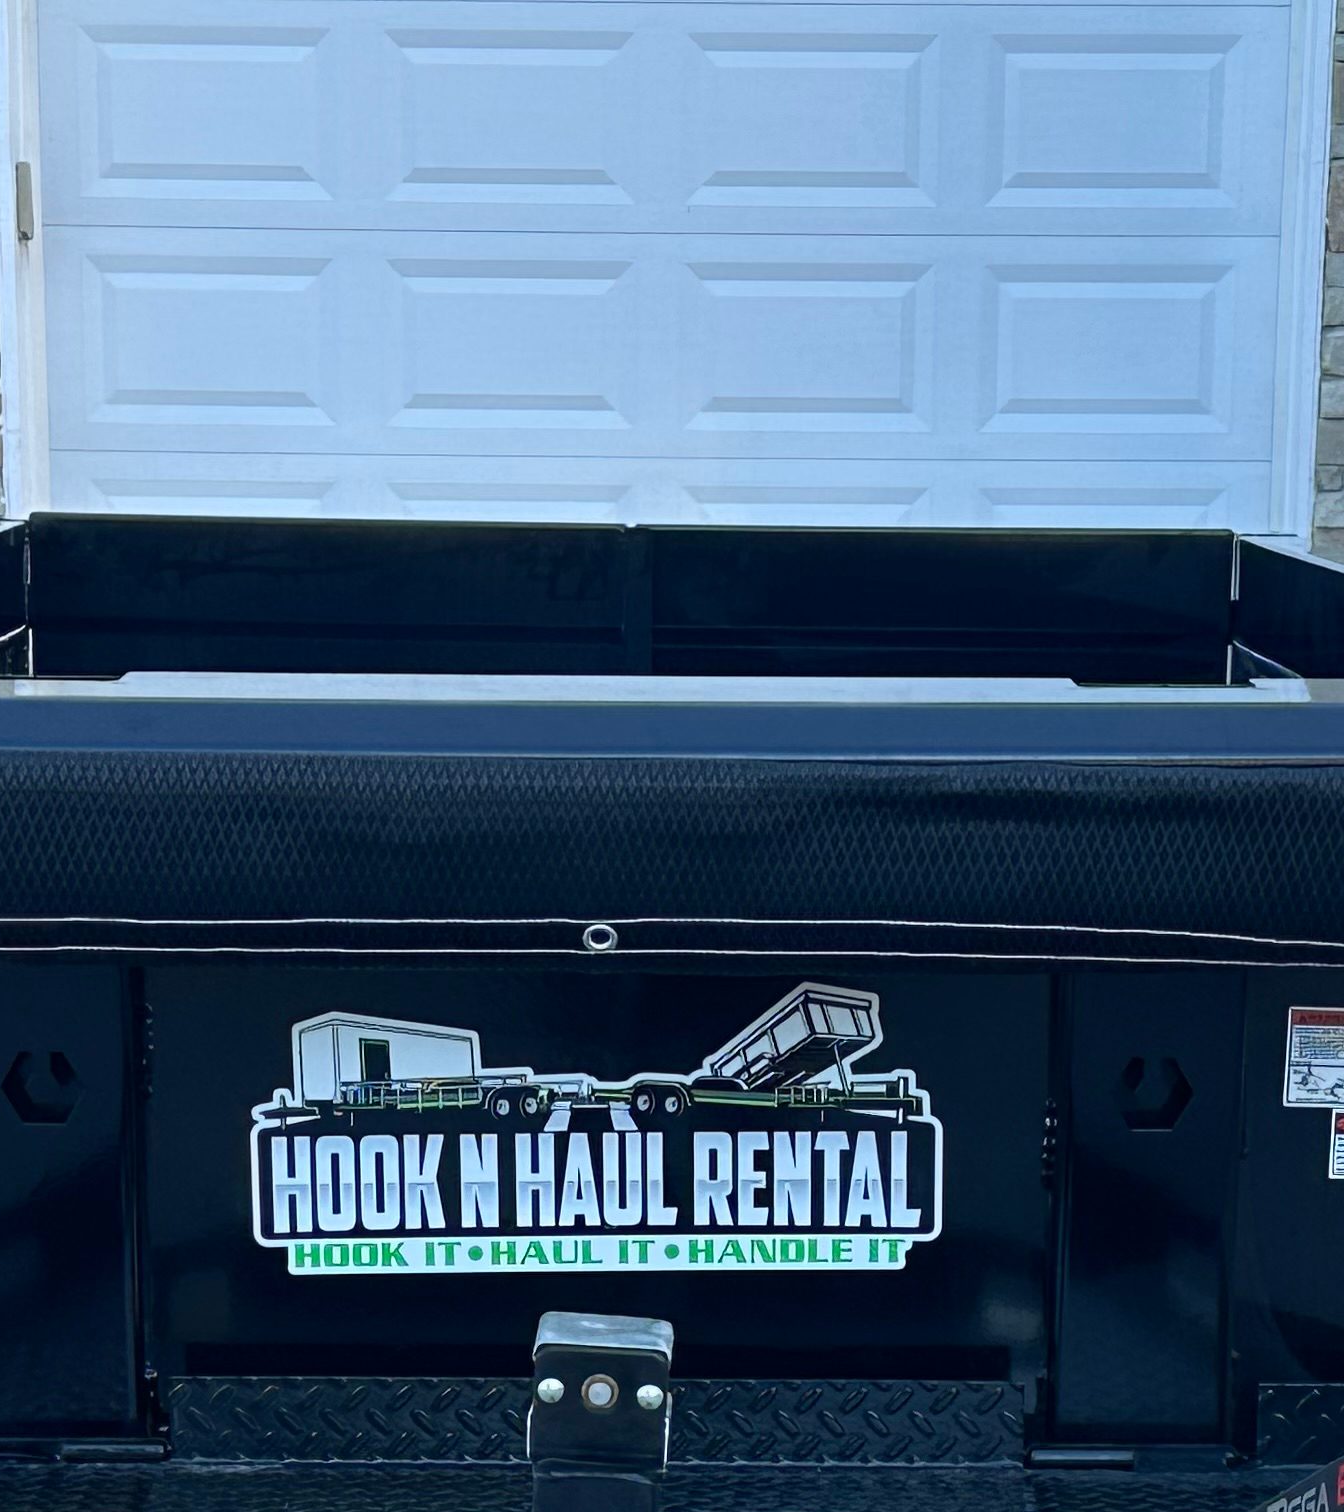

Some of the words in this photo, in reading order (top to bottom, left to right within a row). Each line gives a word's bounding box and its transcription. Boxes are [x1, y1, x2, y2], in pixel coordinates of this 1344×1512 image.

[273, 1134, 445, 1233] HOOK
[460, 1134, 498, 1228] N
[515, 1132, 678, 1229] HAUL
[694, 1131, 922, 1229] RENTAL
[295, 1243, 407, 1268] HOOK
[425, 1242, 462, 1267] IT
[490, 1242, 604, 1266] HAUL
[619, 1241, 655, 1266] IT
[688, 1240, 854, 1264] HANDLE
[868, 1239, 905, 1263] IT
